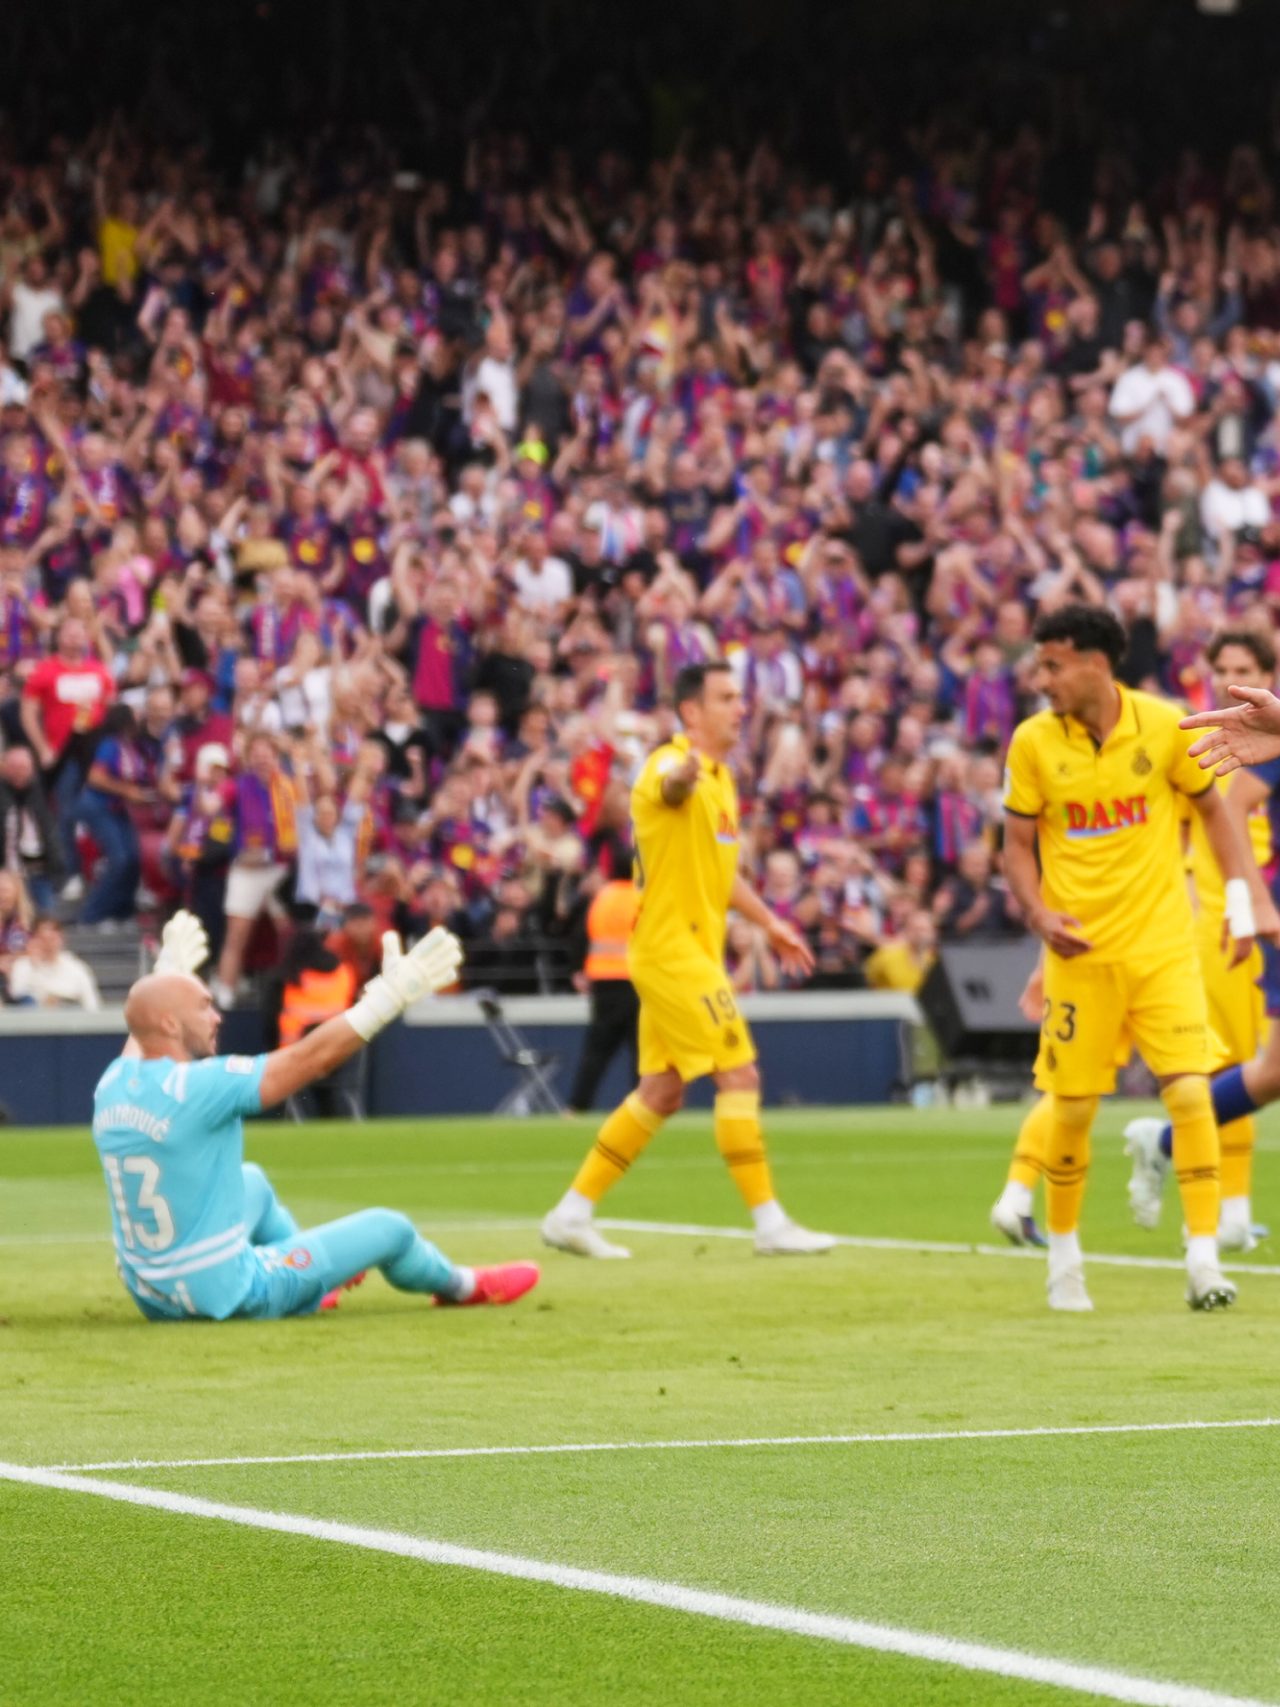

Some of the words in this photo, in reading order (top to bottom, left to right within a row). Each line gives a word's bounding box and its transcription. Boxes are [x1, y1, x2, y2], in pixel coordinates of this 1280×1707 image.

[1065, 793, 1147, 832] DANI
[701, 988, 737, 1026] 19
[103, 1154, 175, 1252] 13
